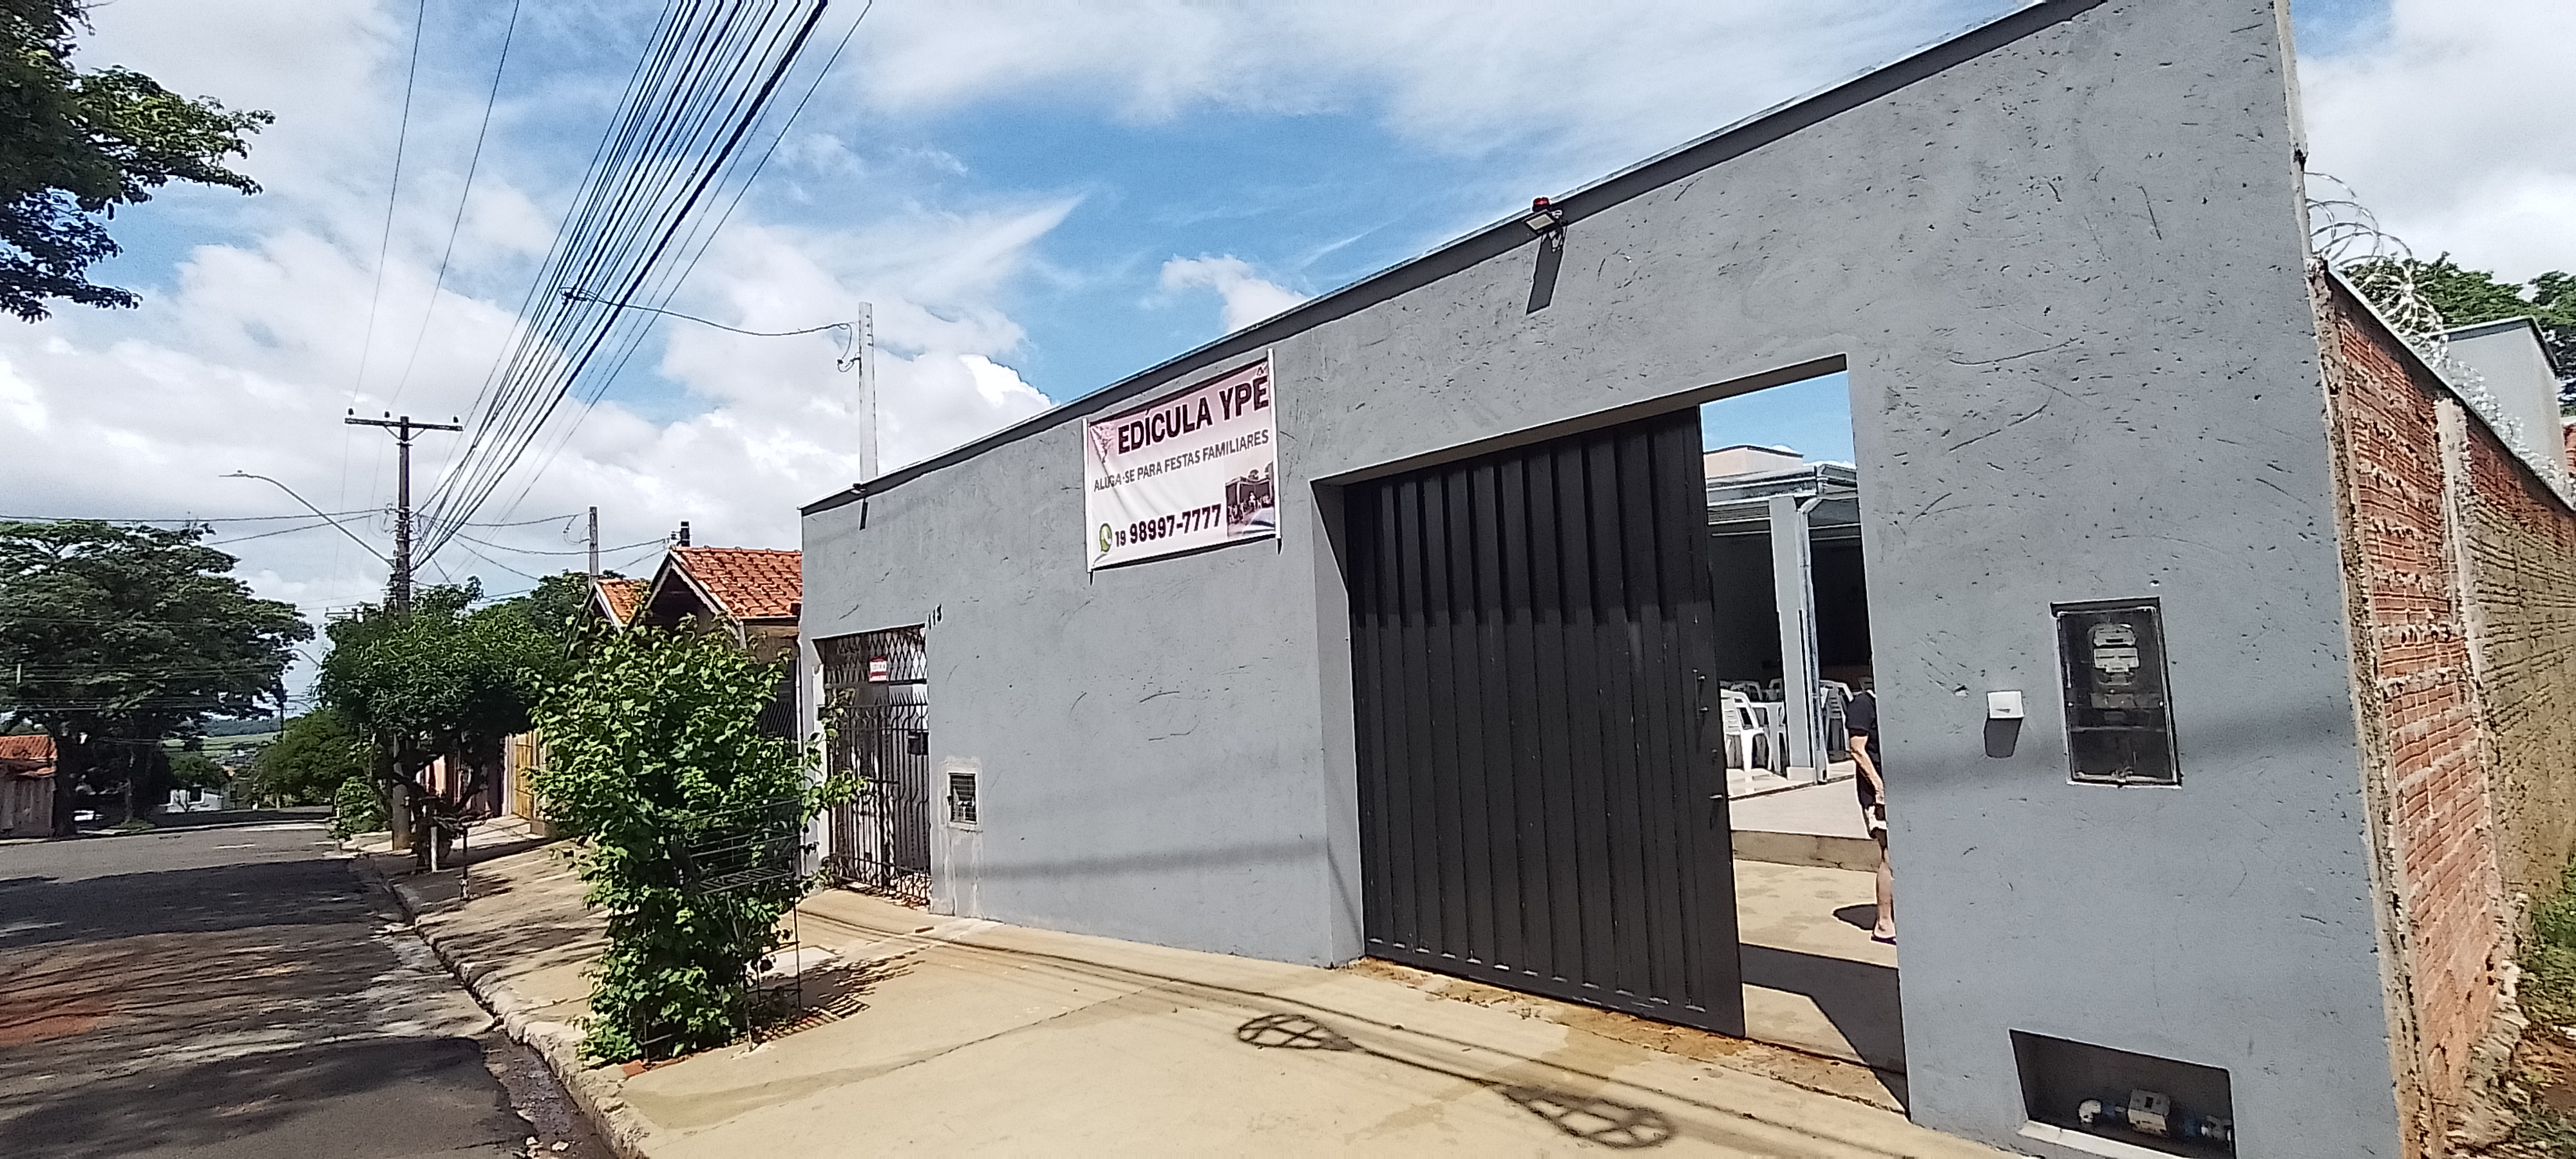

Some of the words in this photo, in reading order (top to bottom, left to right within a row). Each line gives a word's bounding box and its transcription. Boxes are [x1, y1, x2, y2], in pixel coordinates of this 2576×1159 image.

[1118, 397, 1213, 455] EDÍCULA
[1219, 366, 1269, 420] YPÊ
[1094, 469, 1135, 492] ALUGA-SE
[1137, 462, 1162, 480] PARA
[1164, 451, 1200, 473] FESTAS
[1203, 429, 1269, 462] FAMILIARES
[1115, 531, 1126, 547] 19
[1130, 504, 1222, 545] 98997-7777
